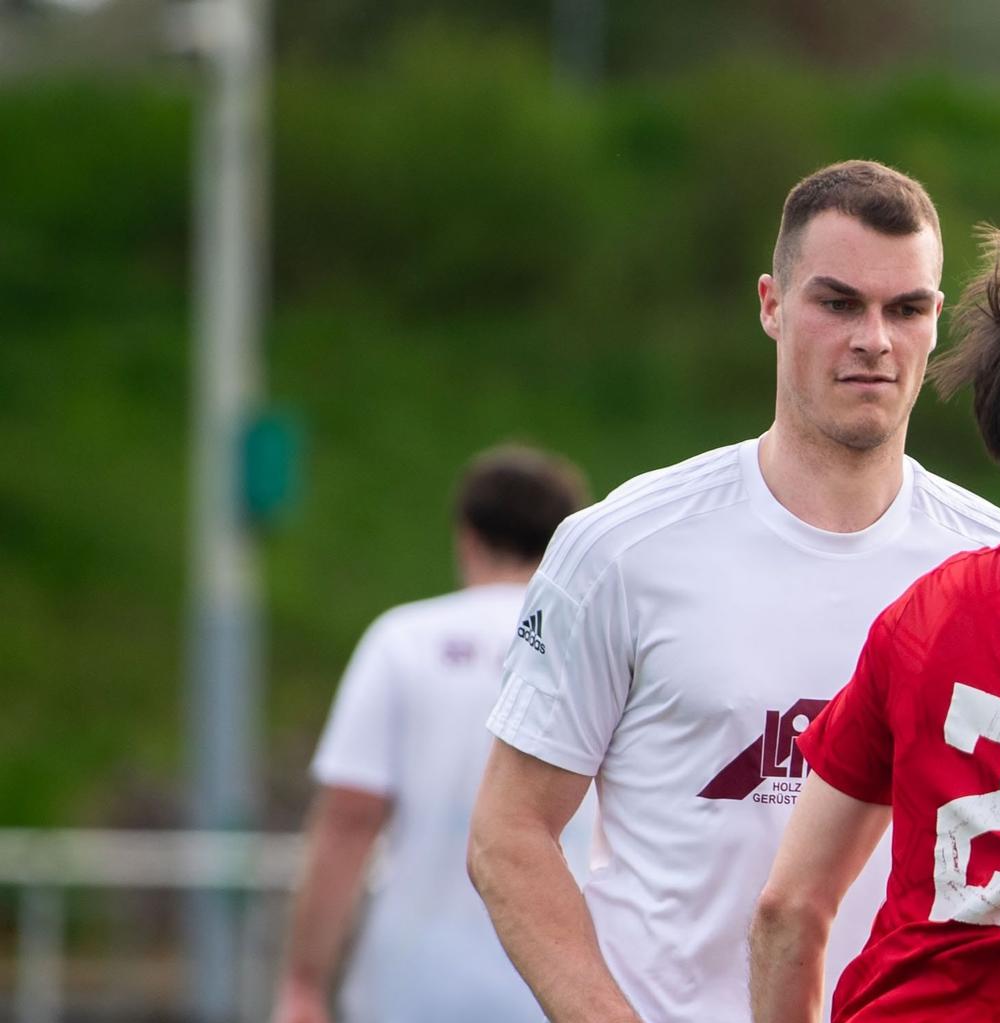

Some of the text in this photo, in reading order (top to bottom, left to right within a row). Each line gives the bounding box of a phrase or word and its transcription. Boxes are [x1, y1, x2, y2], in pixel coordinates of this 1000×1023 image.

[517, 626, 546, 655] addas
[772, 781, 802, 793] HOLZ
[752, 792, 798, 805] GERÜST
